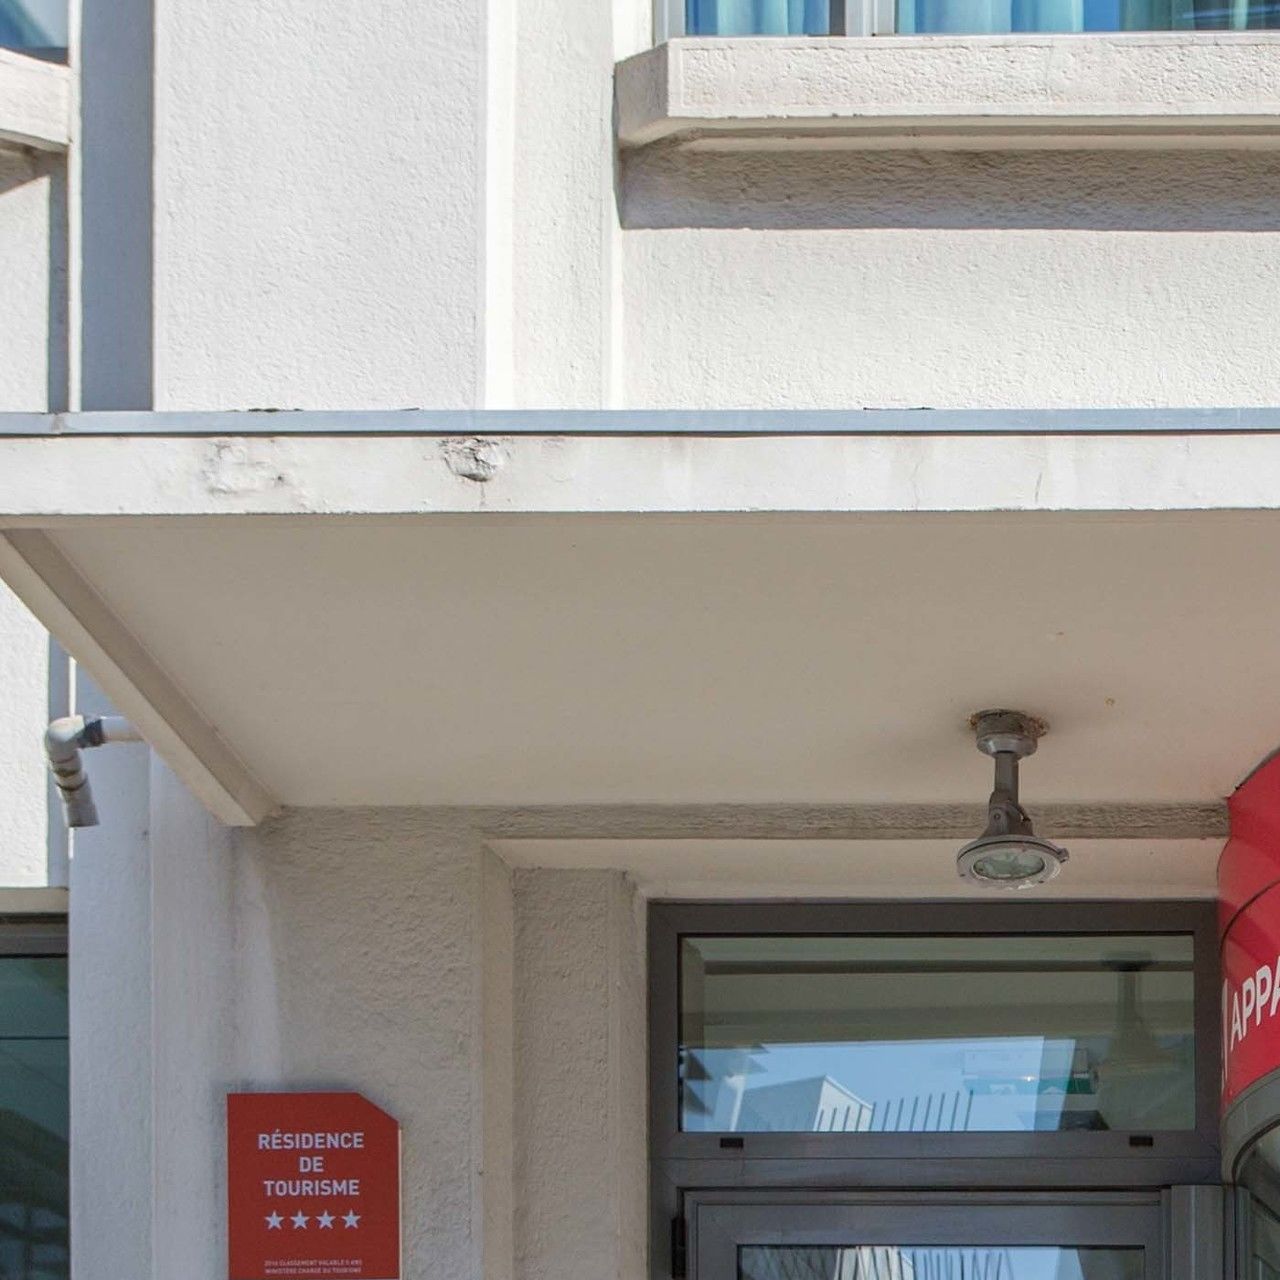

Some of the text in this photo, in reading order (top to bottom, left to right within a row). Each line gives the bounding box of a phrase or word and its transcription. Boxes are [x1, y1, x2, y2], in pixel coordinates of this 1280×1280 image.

[258, 1129, 364, 1149] RÉSIDENCE
[299, 1156, 324, 1172] DE
[264, 1180, 360, 1197] TOURISME
